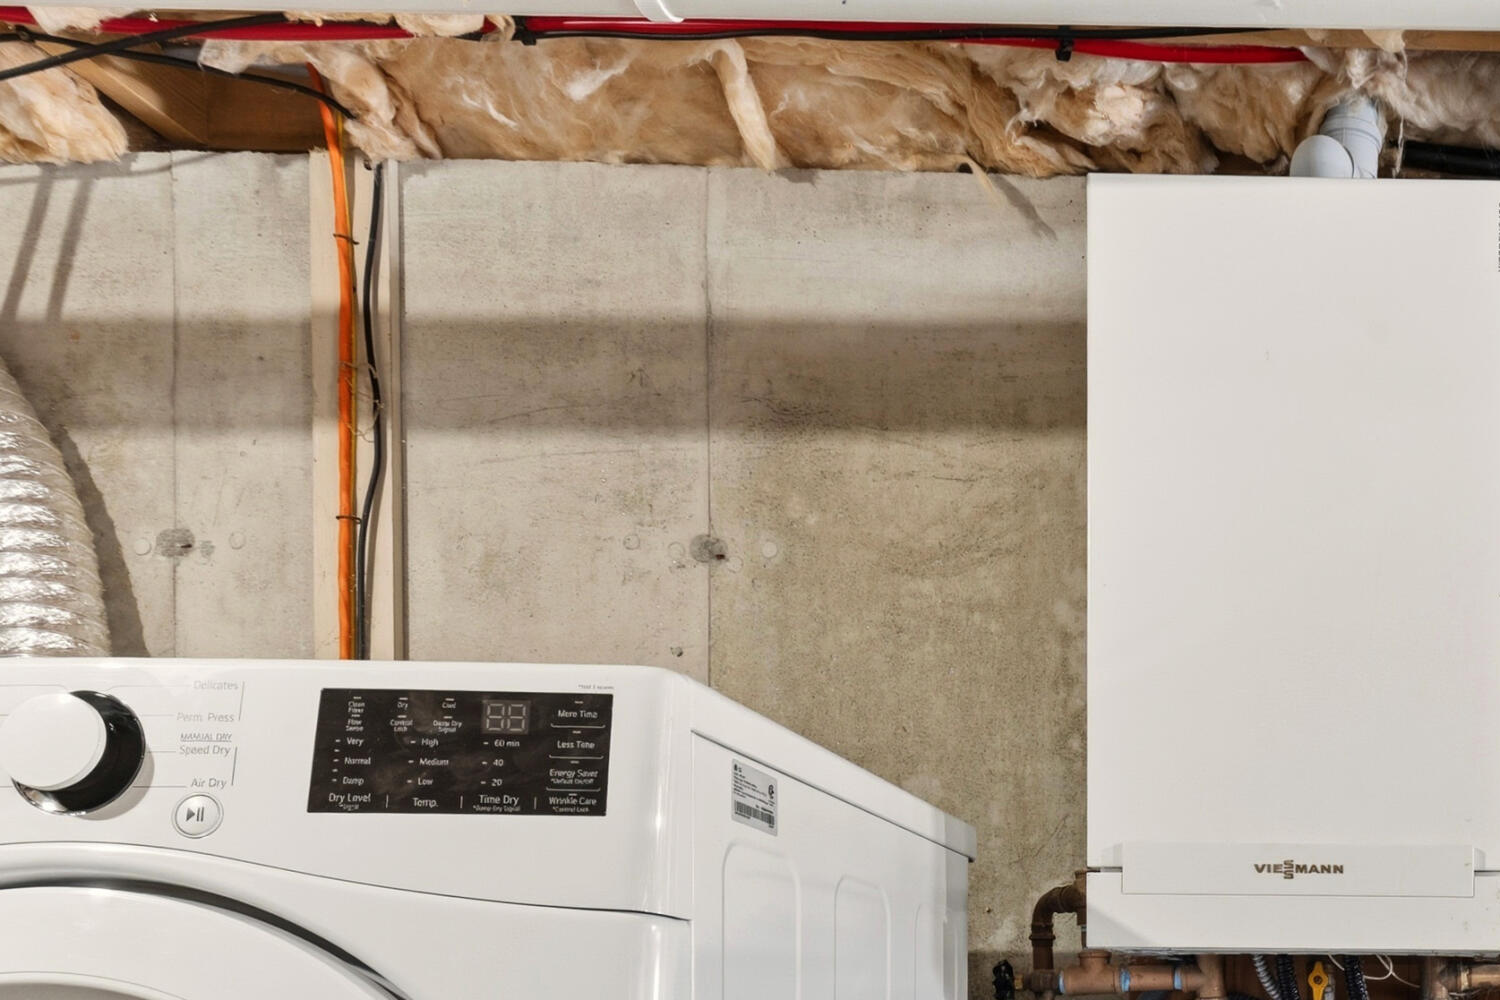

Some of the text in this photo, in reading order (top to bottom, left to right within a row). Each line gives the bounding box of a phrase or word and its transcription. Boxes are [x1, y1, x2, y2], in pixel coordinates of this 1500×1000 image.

[397, 702, 408, 710] Dry
[208, 712, 235, 722] Press
[558, 709, 598, 719] More Time
[216, 733, 232, 741] DRY
[346, 738, 364, 747] Very
[421, 738, 439, 748] High
[557, 740, 595, 749] Less Time
[180, 745, 231, 757] Speed Dry
[344, 757, 371, 765] Normal
[549, 769, 599, 778] Energy Saver
[190, 778, 227, 790] Air Dry
[342, 777, 364, 785] Damp
[328, 793, 371, 803] Dry Level
[413, 797, 438, 808] Temp.
[479, 795, 519, 806] Time Dry
[549, 796, 597, 806] Wrinkle Care
[1253, 859, 1344, 879] VIESSMANN
